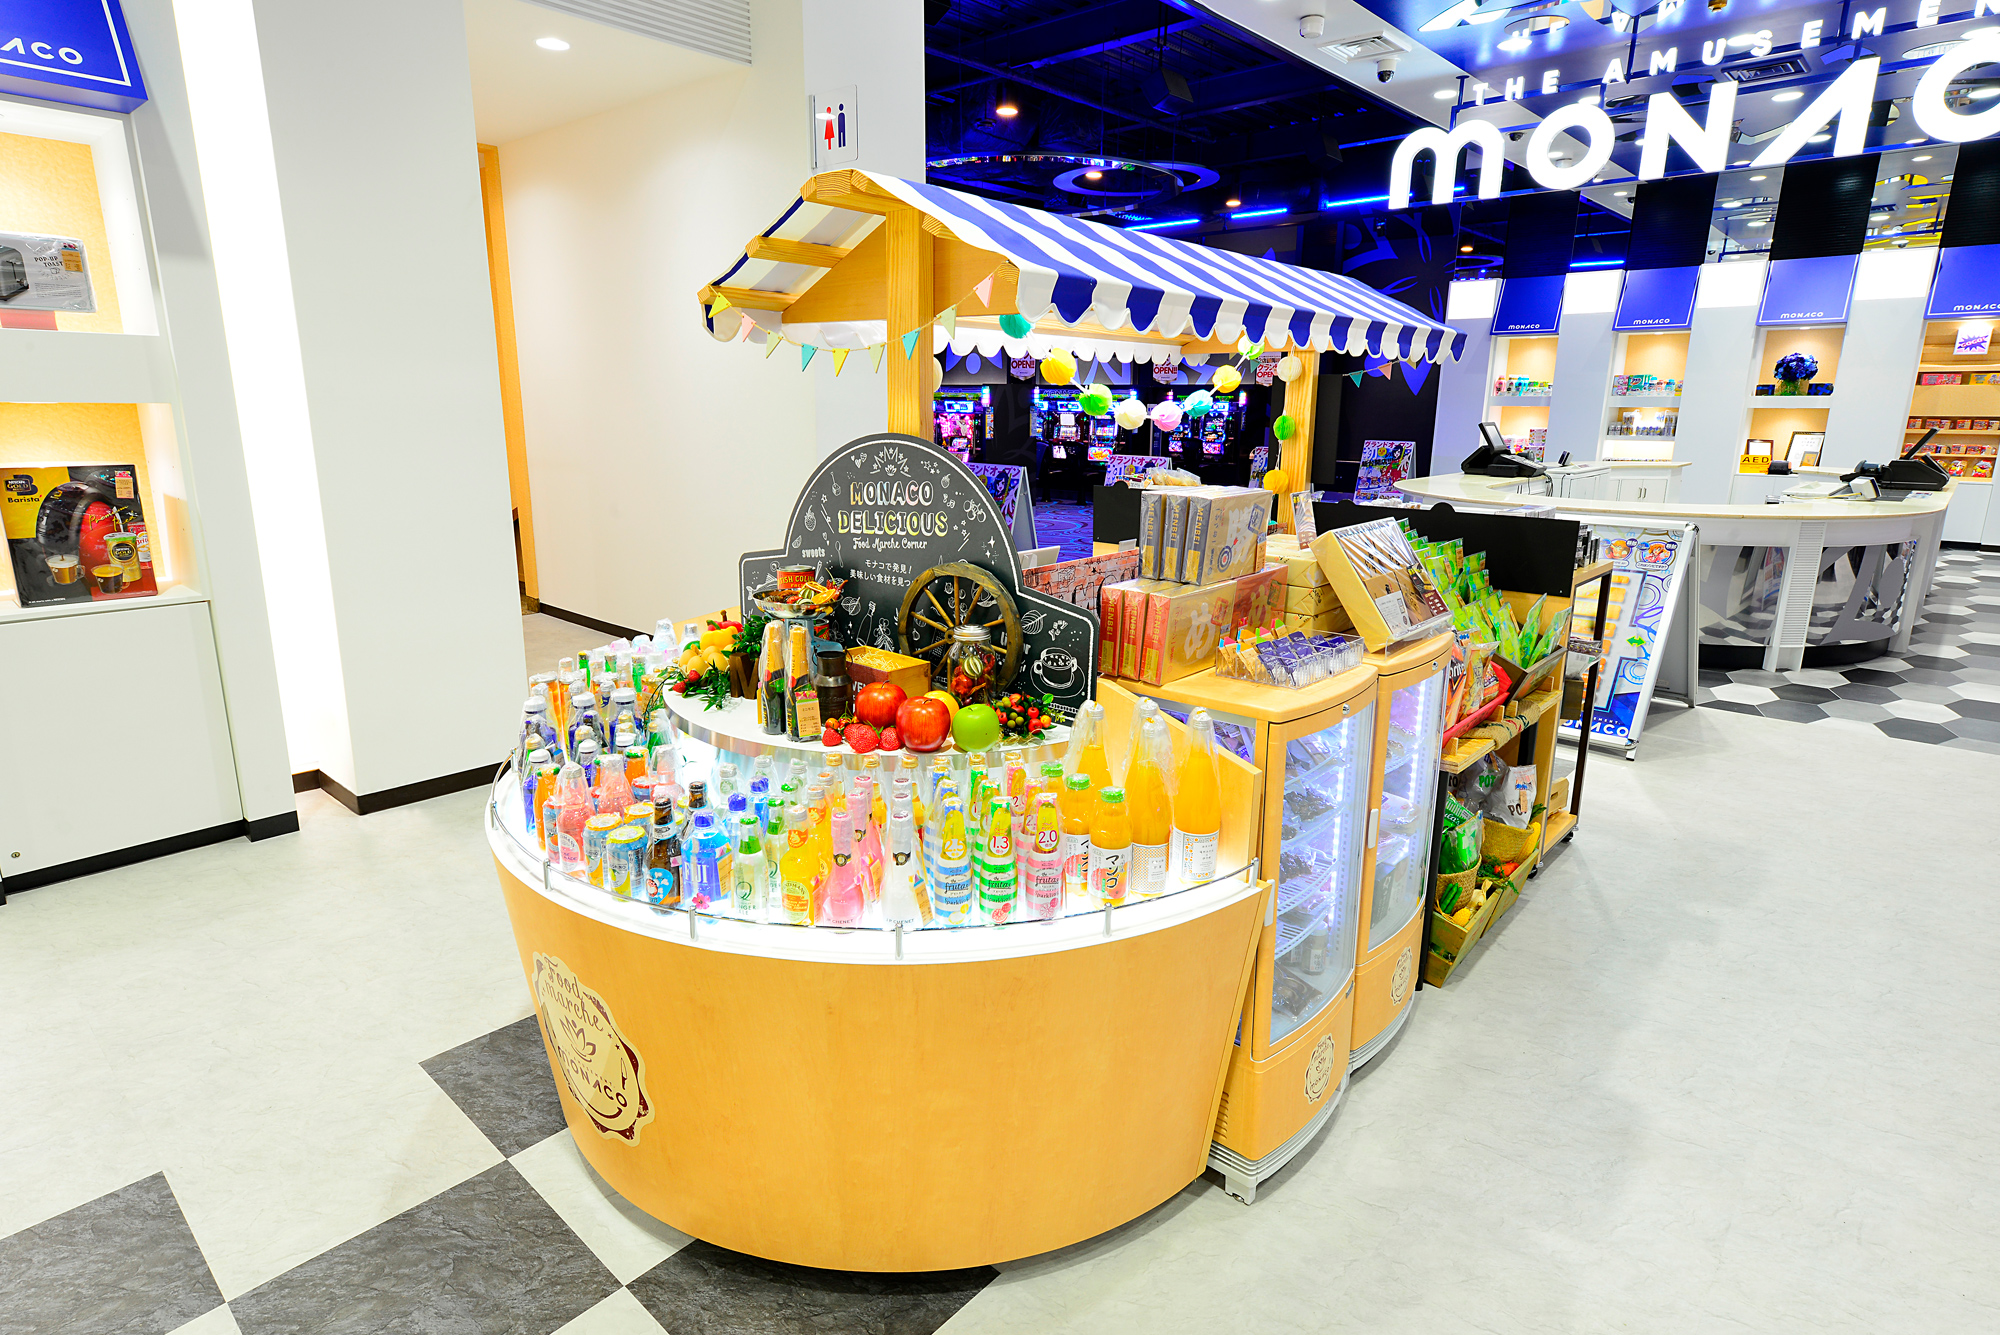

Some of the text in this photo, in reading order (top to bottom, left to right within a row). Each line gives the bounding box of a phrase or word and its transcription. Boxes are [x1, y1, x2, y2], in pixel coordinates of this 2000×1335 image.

[1473, 69, 1560, 106] THE
[1780, 311, 1824, 319] MONACO
[966, 463, 1020, 477] ランドオープン
[850, 480, 934, 506] MONACO
[838, 510, 949, 537] DELICIOUS
[1147, 503, 1155, 539] MENBEI
[1171, 505, 1180, 542] MENBEI
[1193, 507, 1204, 545] MENBEI
[852, 536, 928, 552] Food Marche Corner
[849, 568, 914, 587] 美味しい食材を見つ
[1107, 598, 1115, 635] MENBEI
[1129, 602, 1138, 639] MENBEI
[1152, 606, 1163, 644] MENBEI
[1563, 719, 1629, 737] ONACO
[944, 838, 966, 853] 2.5
[992, 835, 1009, 849] 1.3
[1038, 830, 1058, 844] 2.0
[544, 956, 583, 1000] Food
[545, 979, 604, 1032] marche
[557, 1045, 628, 1108] MONACO
